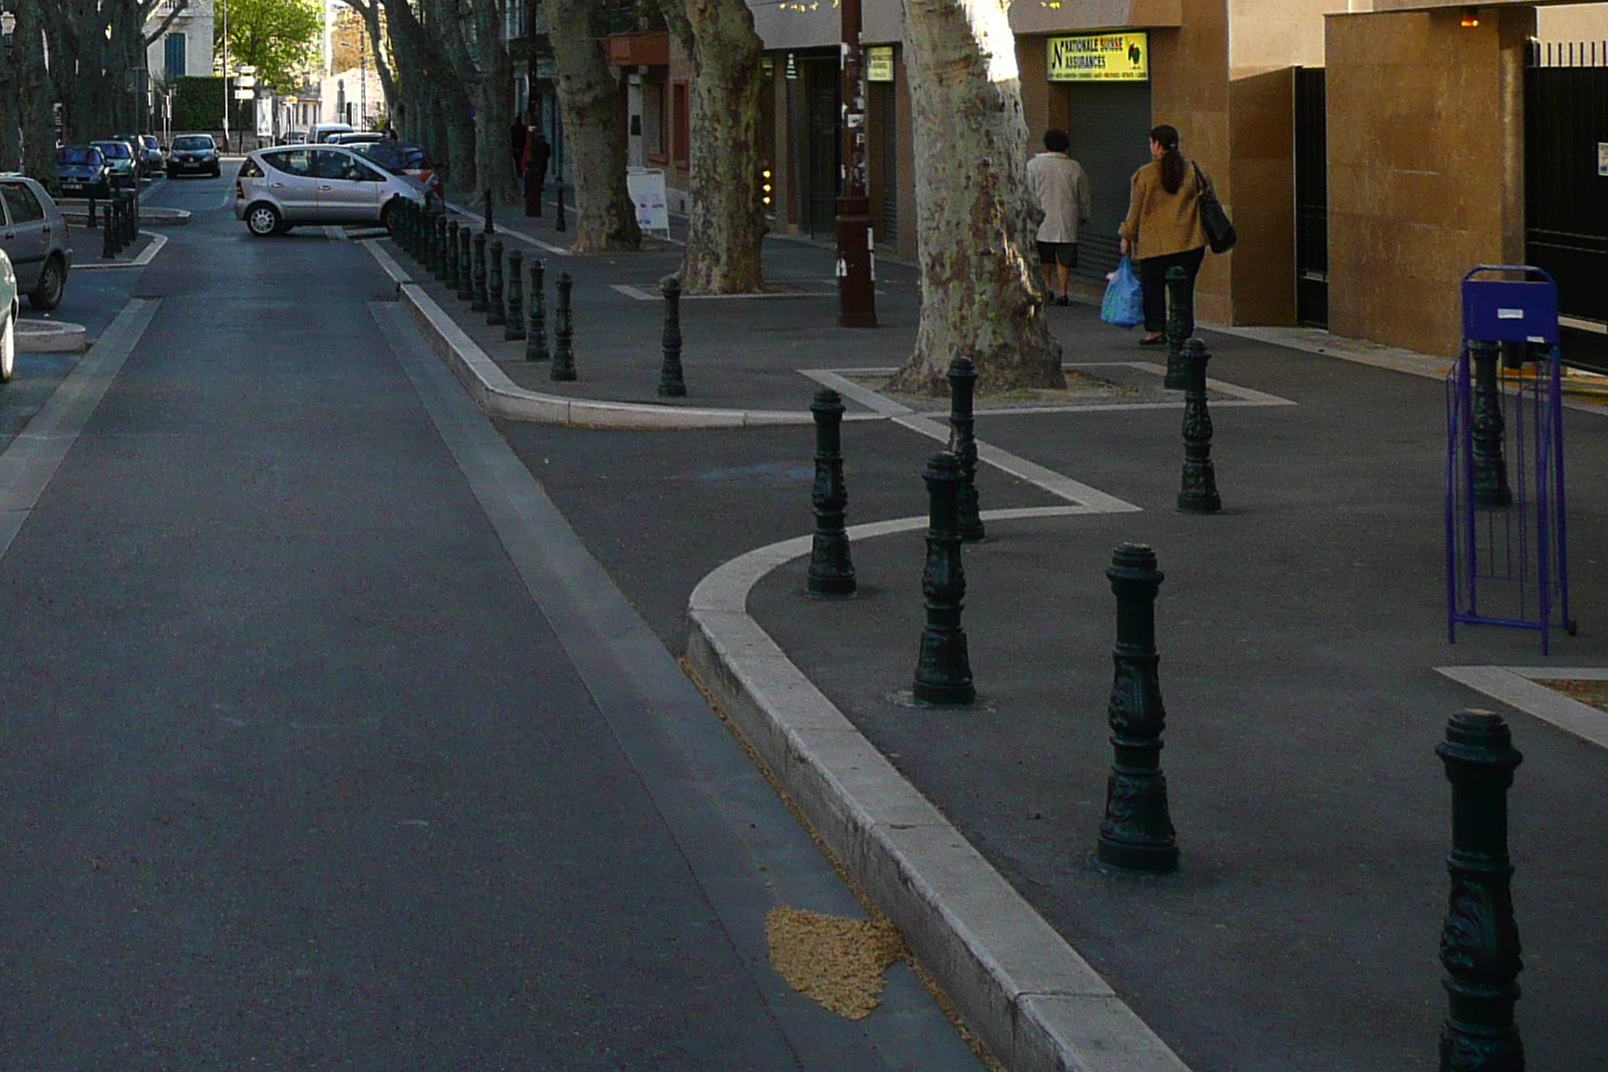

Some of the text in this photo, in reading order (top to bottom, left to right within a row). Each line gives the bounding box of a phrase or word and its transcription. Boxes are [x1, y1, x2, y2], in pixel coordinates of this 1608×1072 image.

[1064, 37, 1123, 53] NATIONALE SUISSE
[1065, 55, 1106, 69] ASSURANCES
